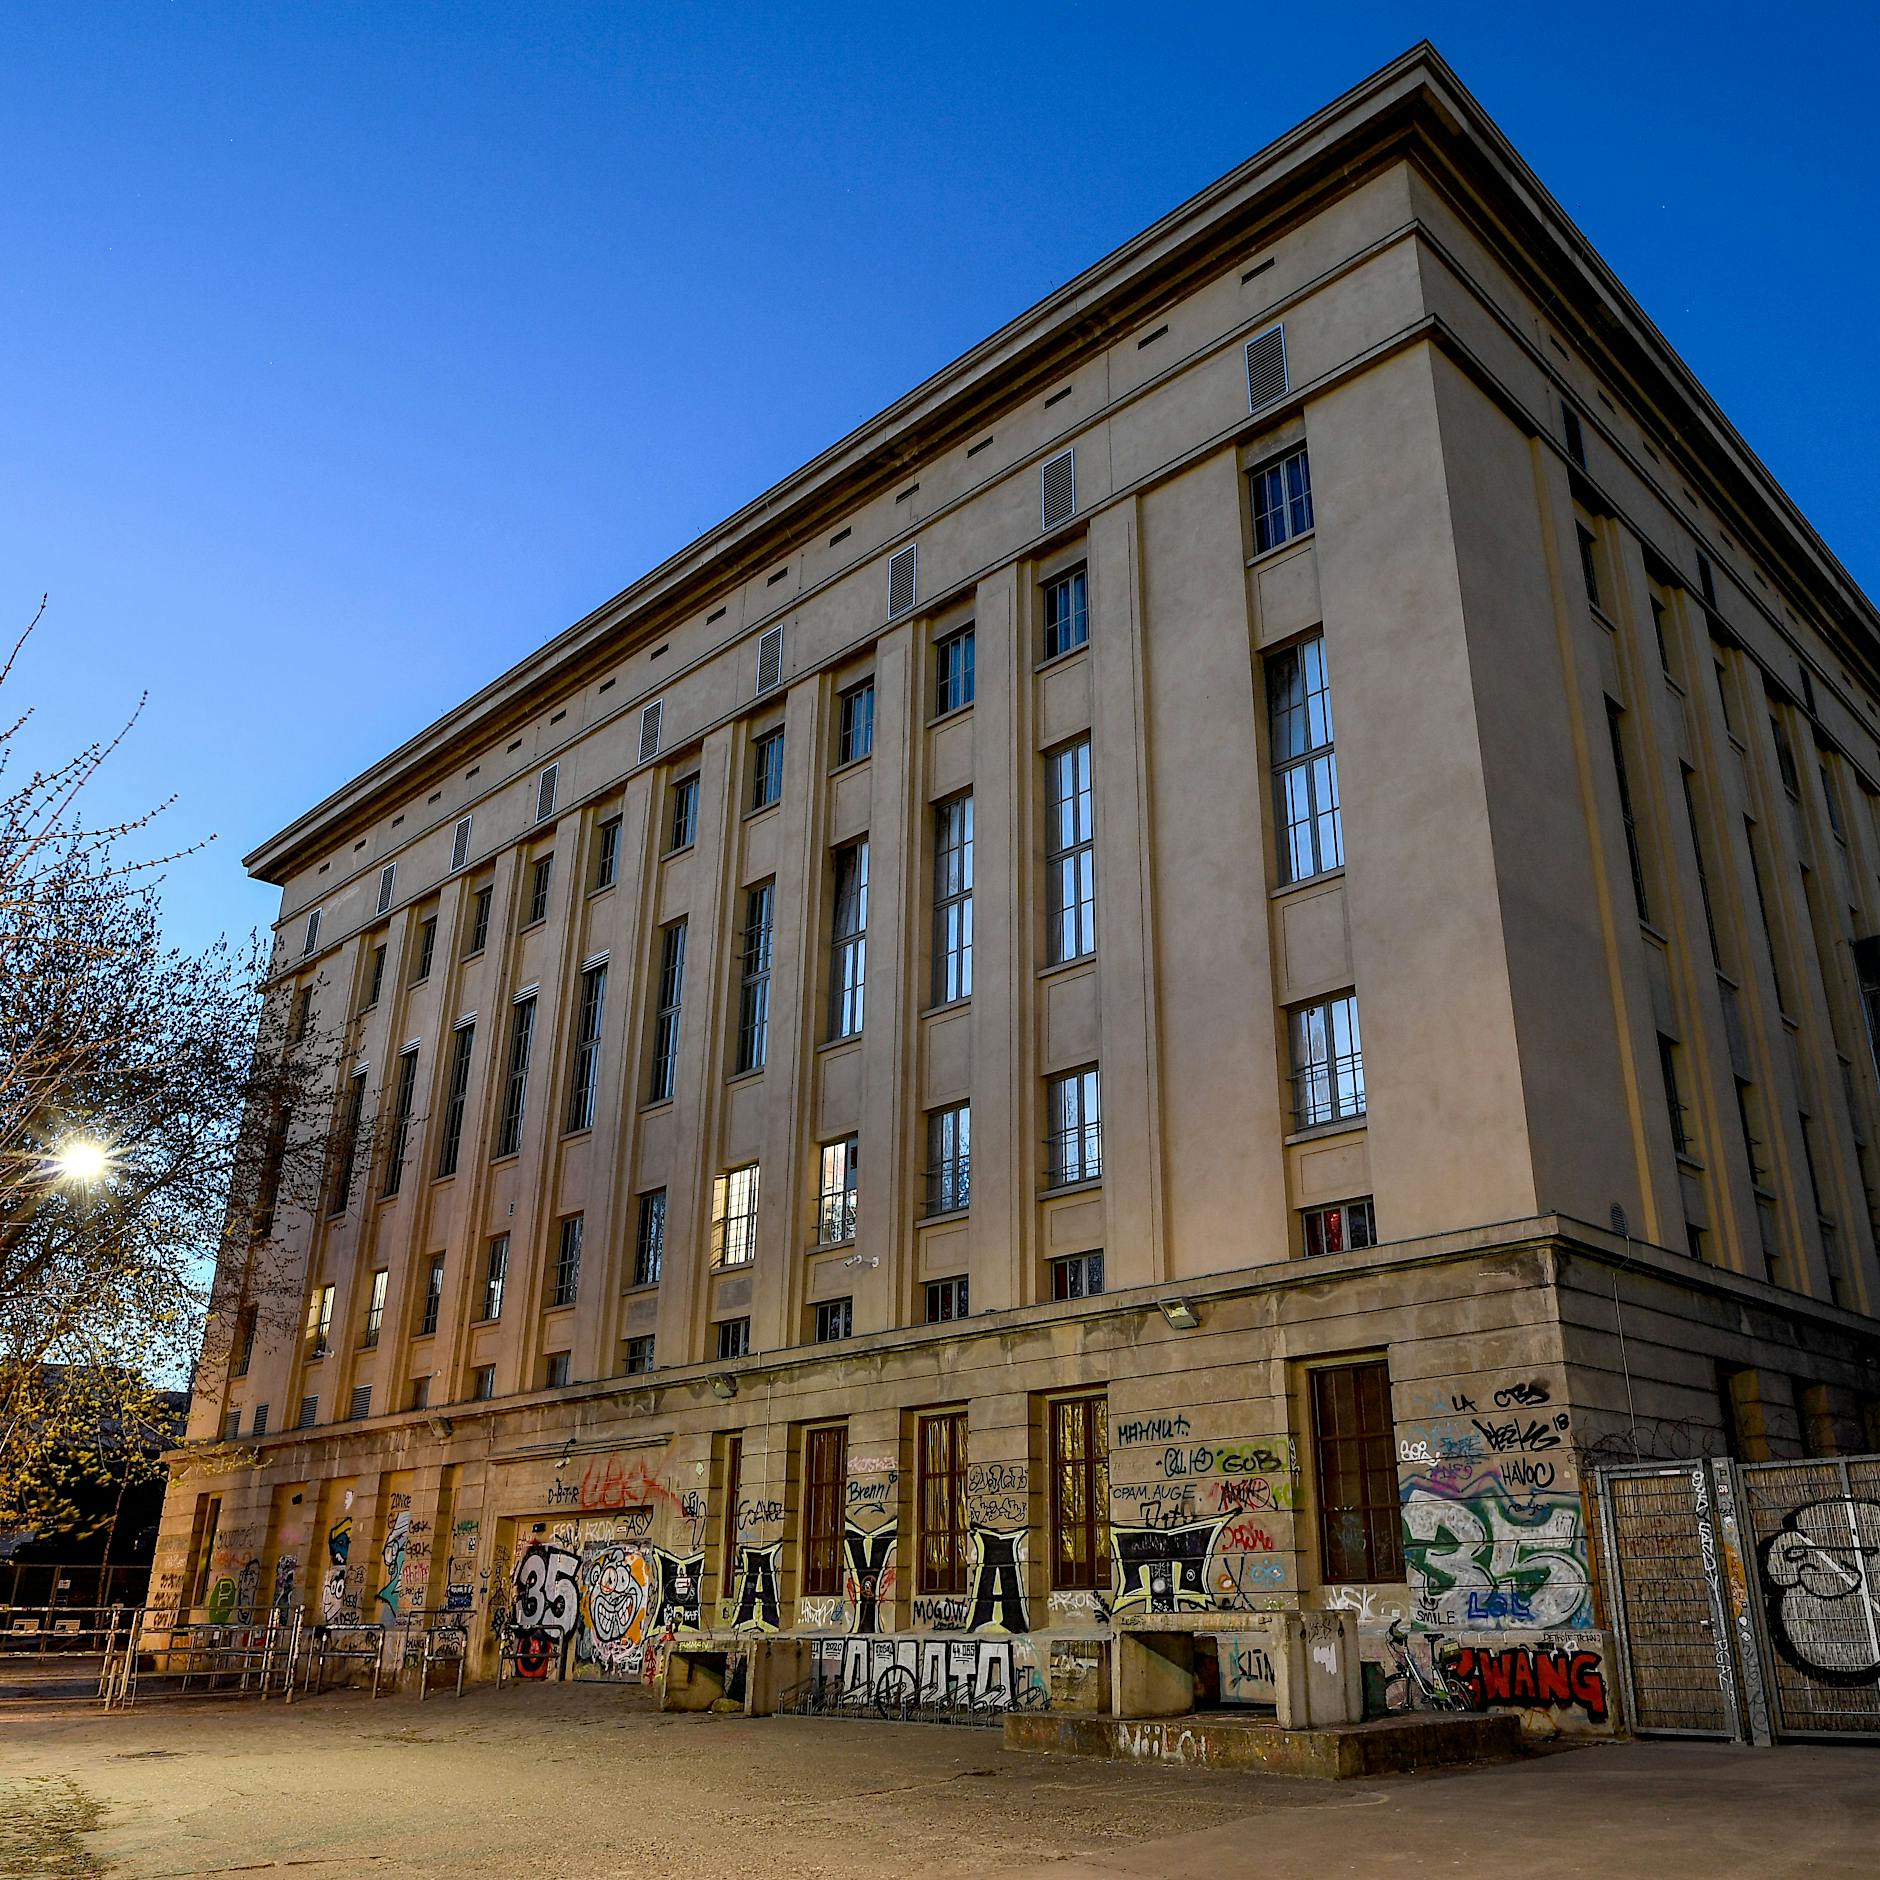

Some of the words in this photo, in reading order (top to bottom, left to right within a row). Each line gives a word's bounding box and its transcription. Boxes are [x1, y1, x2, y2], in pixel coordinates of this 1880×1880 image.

[1451, 1393, 1477, 1412] LA
[1501, 1458, 1555, 1488] HAVOC
[514, 1549, 581, 1640] 35
[1415, 1610, 1456, 1626] SMILE
